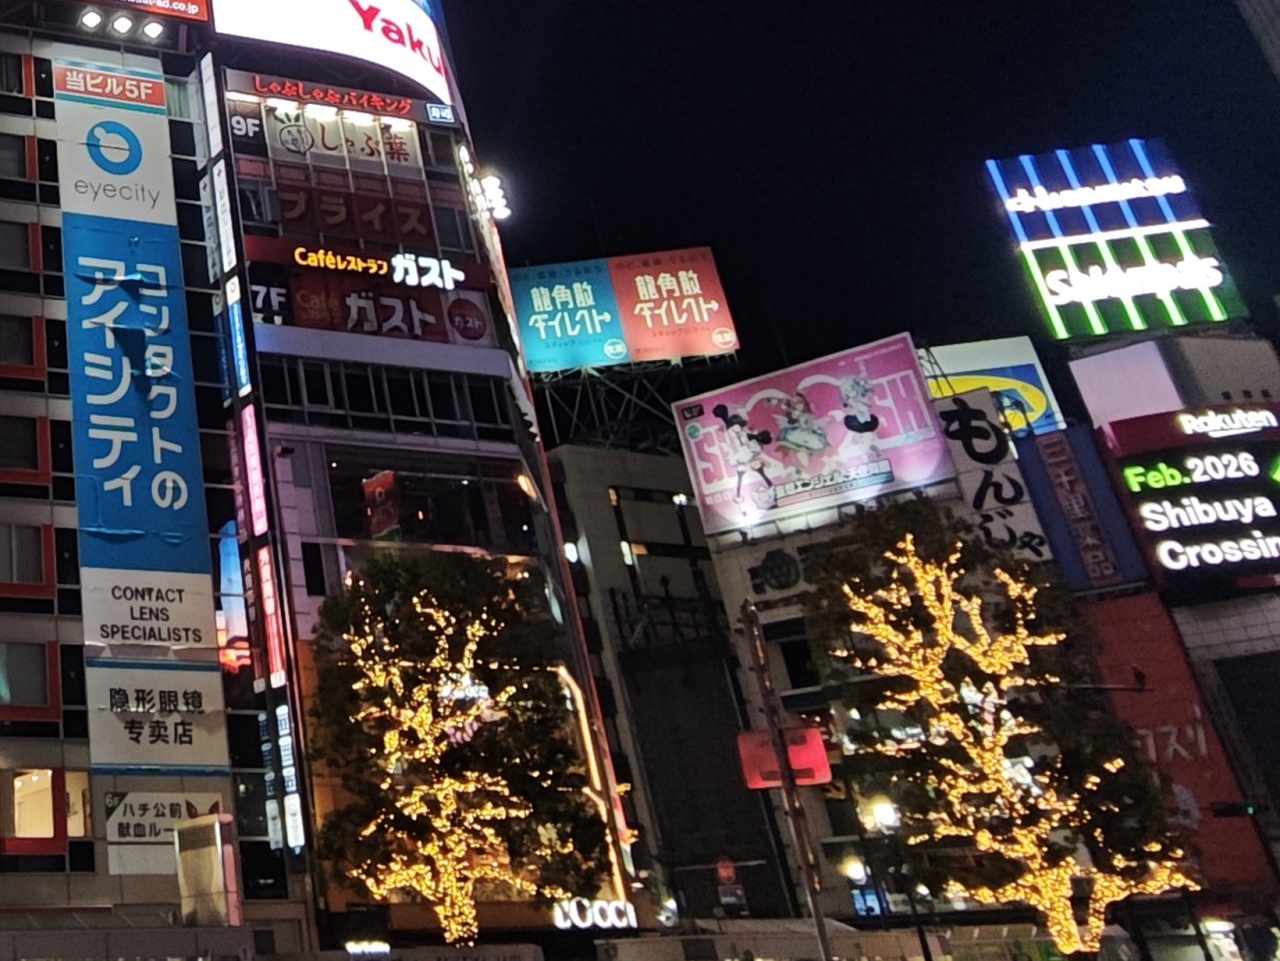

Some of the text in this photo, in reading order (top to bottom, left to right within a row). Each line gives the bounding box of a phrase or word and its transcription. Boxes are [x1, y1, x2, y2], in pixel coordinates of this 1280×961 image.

[65, 70, 154, 101] 当ビル5F
[253, 75, 412, 115] しゃぶしゃぶバイキング
[231, 116, 260, 137] 9F
[74, 177, 160, 210] eyecity
[391, 253, 465, 290] ガスト
[251, 285, 287, 311] 7F
[344, 291, 437, 336] ガスト
[78, 257, 141, 506] アイシティ
[1178, 409, 1278, 435] Rakuten
[939, 397, 1052, 558] もんじゃ
[1140, 496, 1278, 532] Shibuya
[111, 585, 184, 604] CONTACT
[130, 605, 170, 622] LENS
[100, 623, 202, 644] SPECIALISTS
[109, 687, 204, 714] 隐形眼镜
[124, 719, 194, 745] 专卖店
[122, 802, 182, 819] ハチ公前
